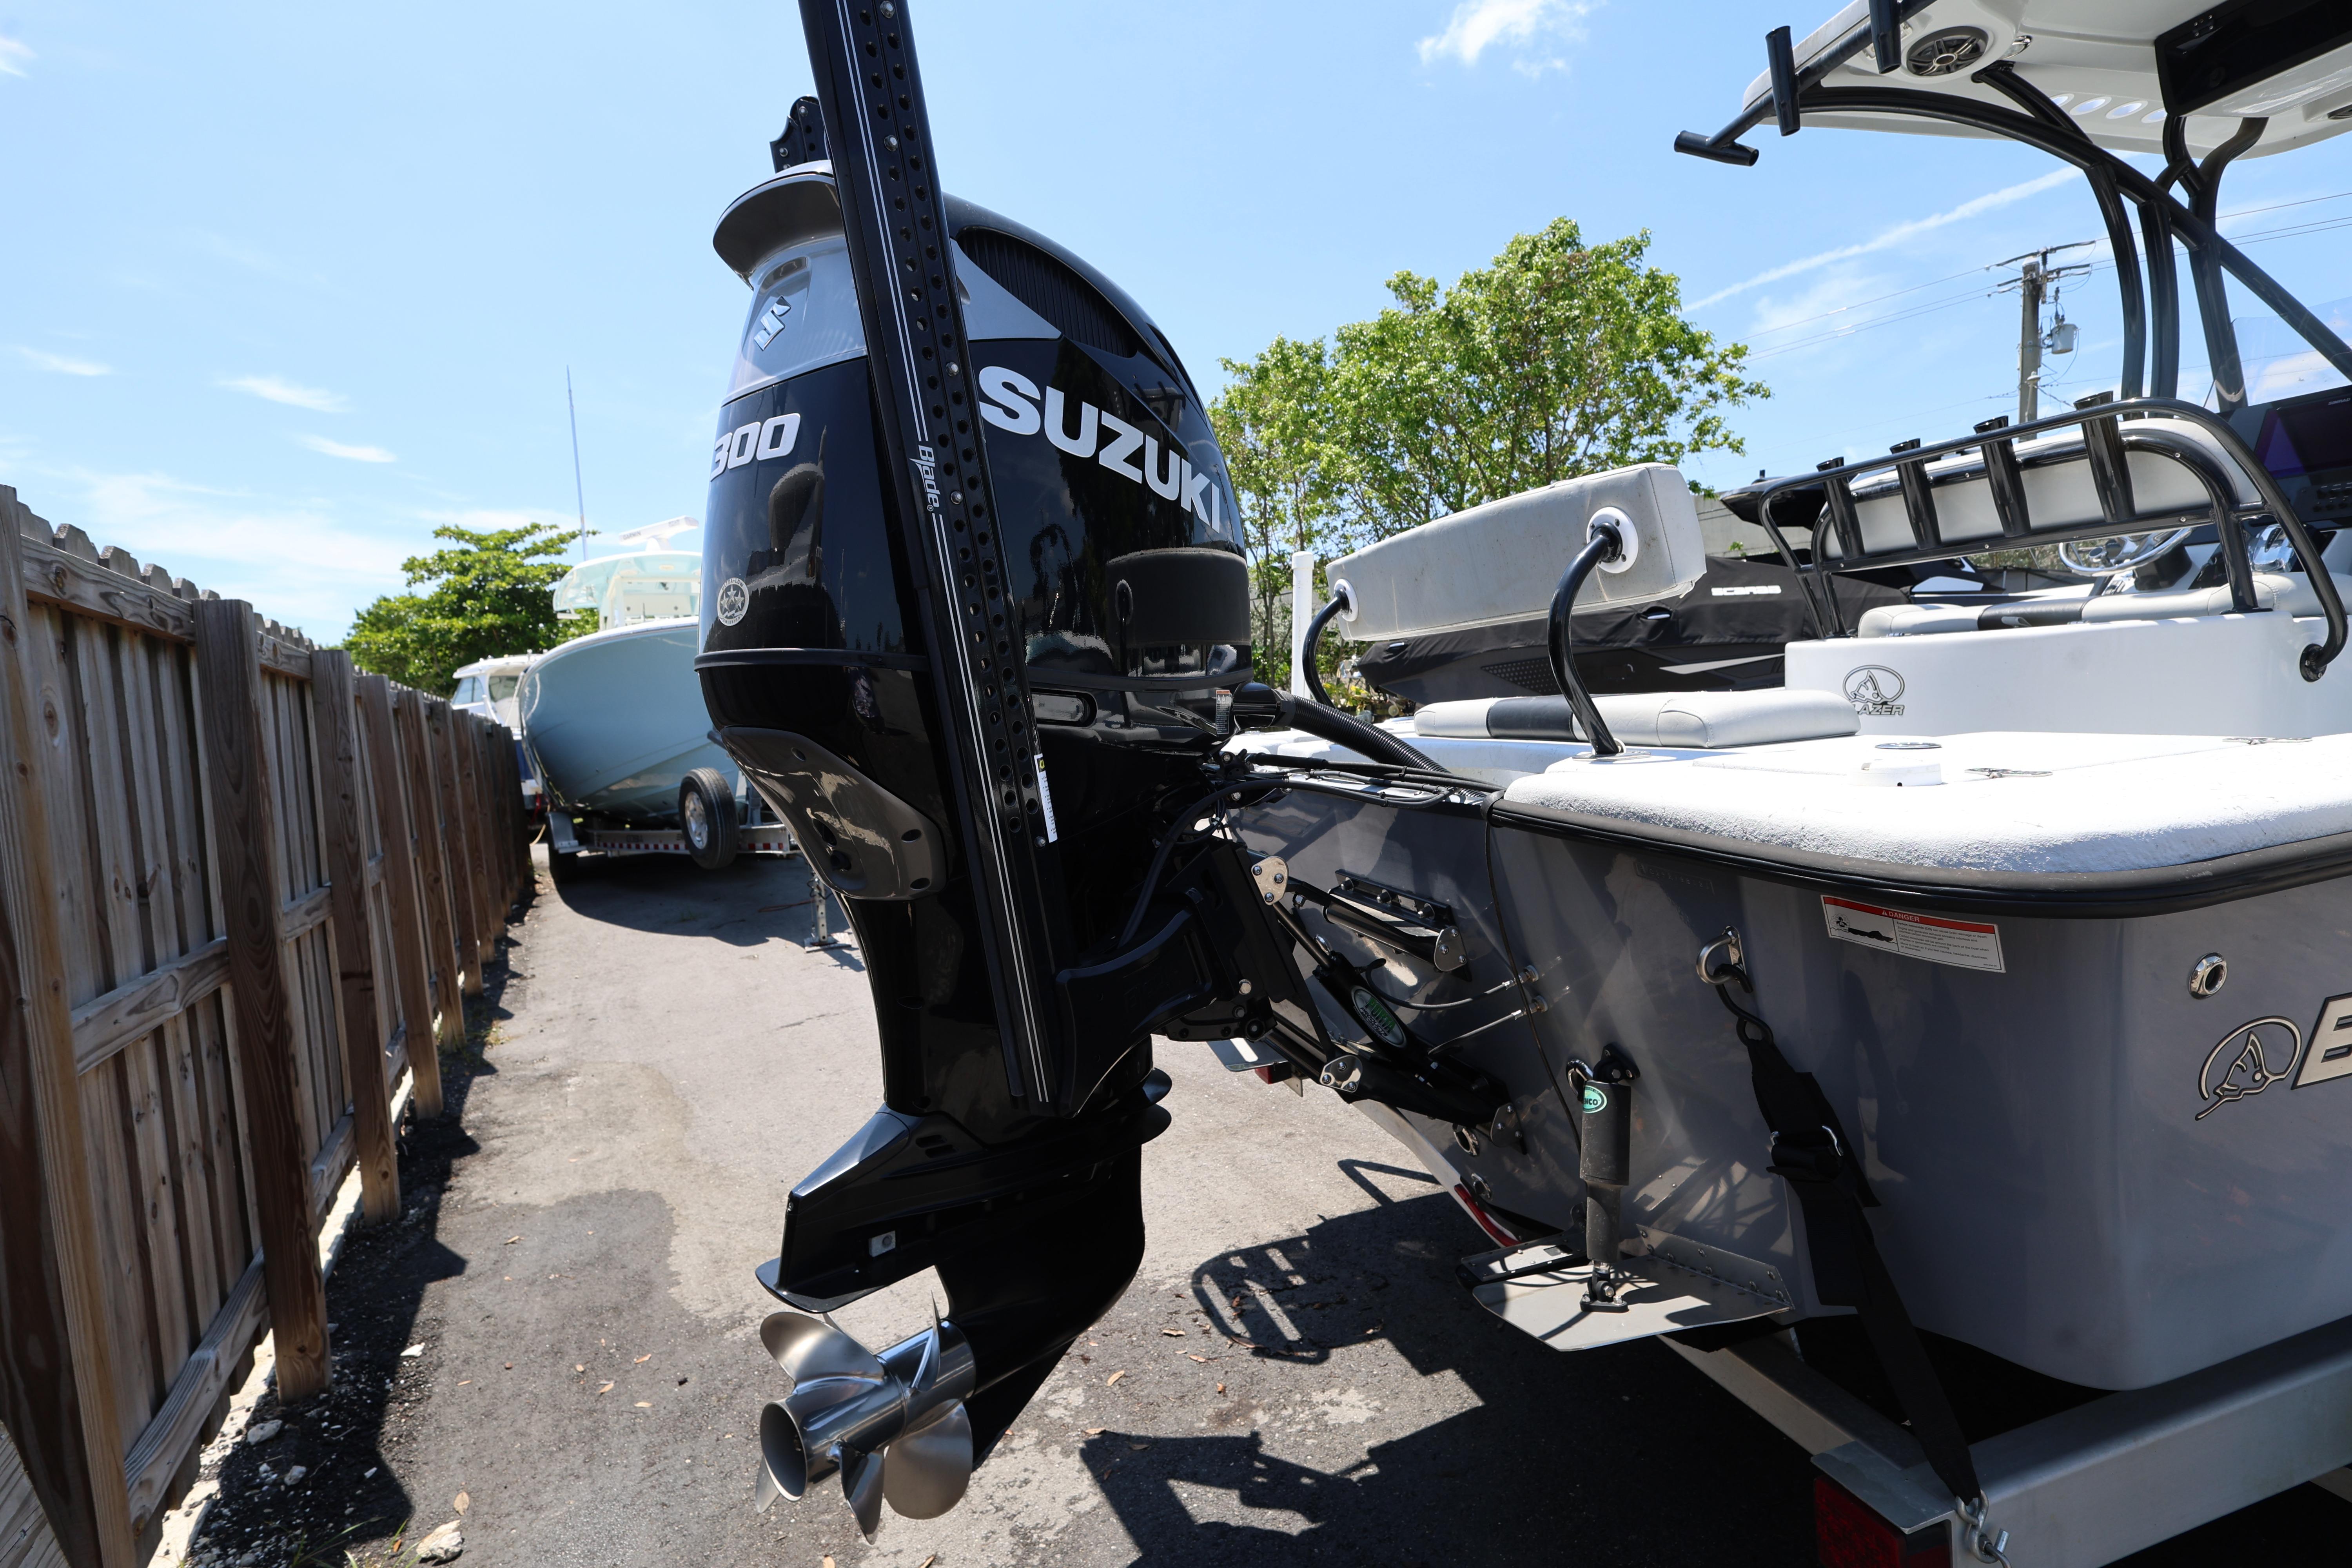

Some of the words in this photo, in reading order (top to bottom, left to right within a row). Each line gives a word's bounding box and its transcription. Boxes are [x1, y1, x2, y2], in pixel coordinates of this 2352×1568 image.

[711, 413, 800, 482] 300
[978, 366, 1220, 534] SUZUKI
[1889, 911, 1920, 922] DANGER
[1360, 1007, 1388, 1036] PRODUCTS
[1365, 996, 1396, 1034] PORTA
